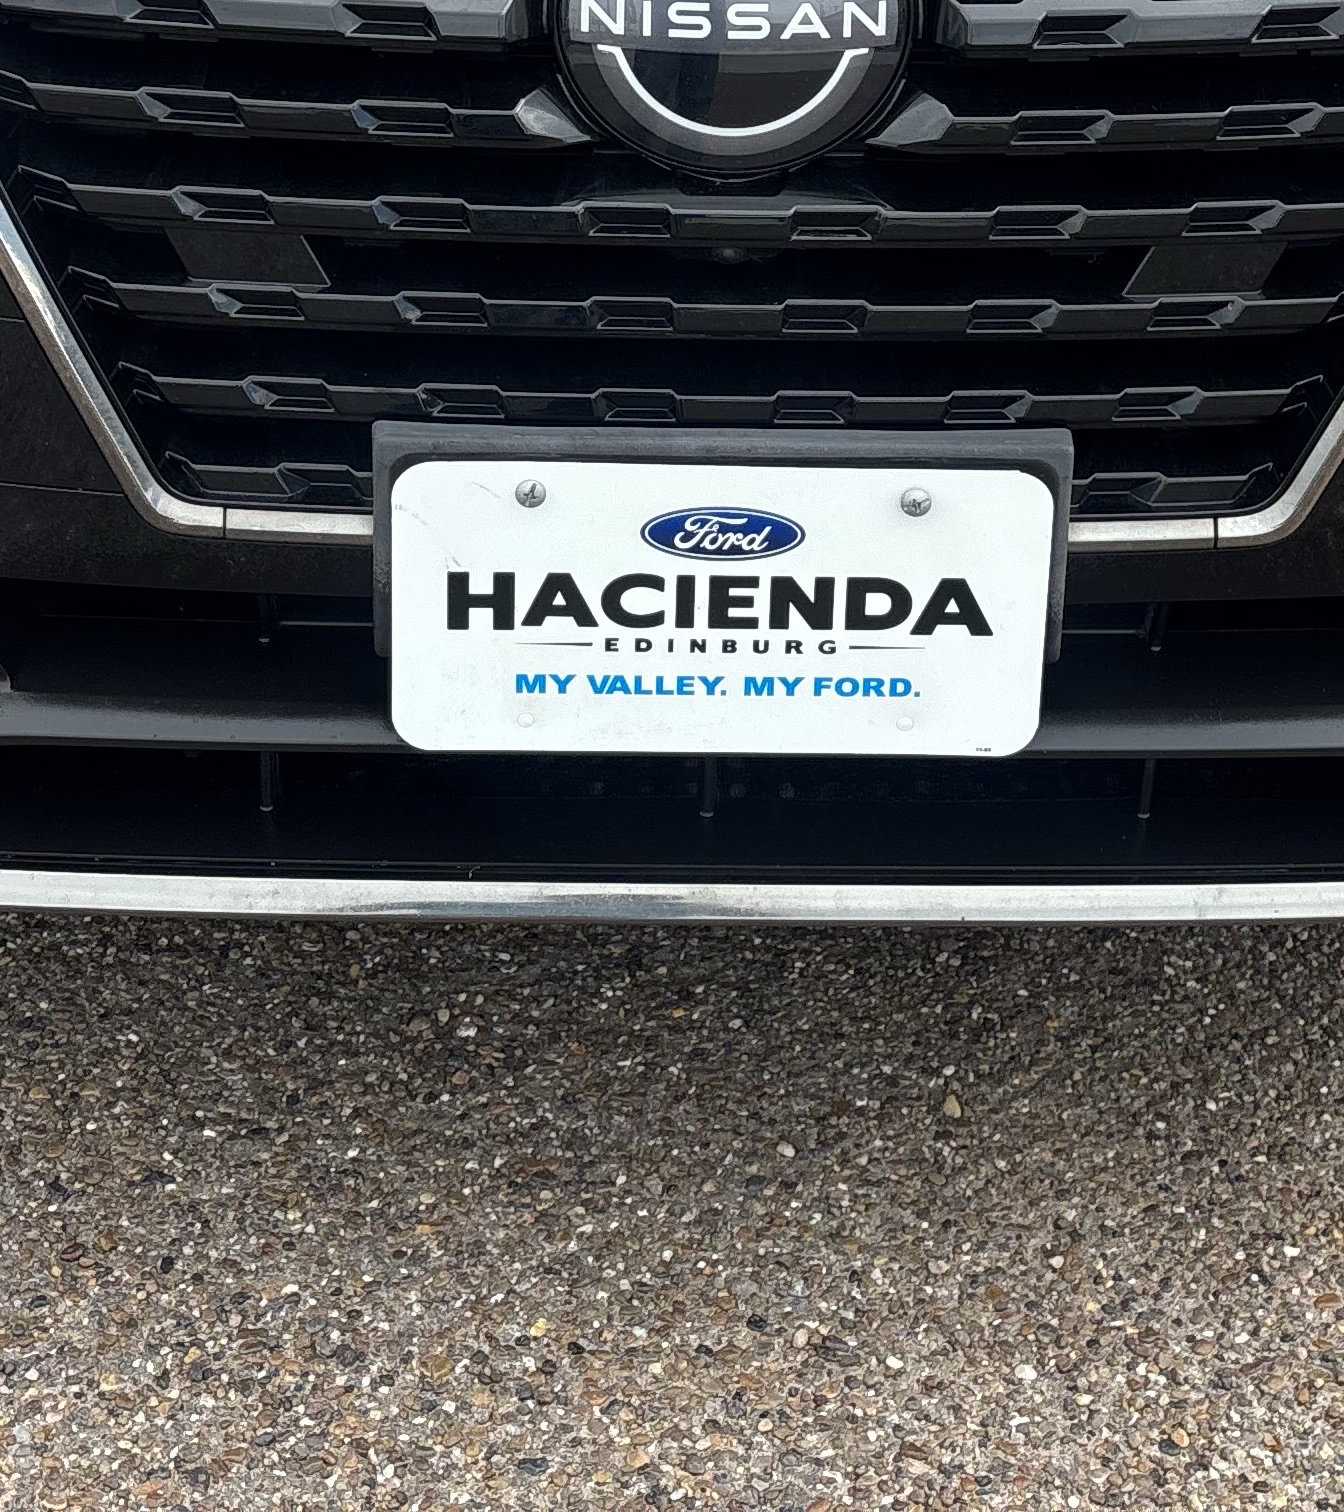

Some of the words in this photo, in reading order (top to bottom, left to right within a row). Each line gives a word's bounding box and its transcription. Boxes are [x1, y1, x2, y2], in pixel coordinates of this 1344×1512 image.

[674, 515, 773, 551] Ford
[446, 571, 994, 637] HACIENDA
[604, 637, 837, 655] EDINBURG
[515, 673, 577, 695] MY
[586, 674, 727, 696] VALLEY.
[743, 676, 805, 697] MY
[813, 677, 921, 698] FORD.
